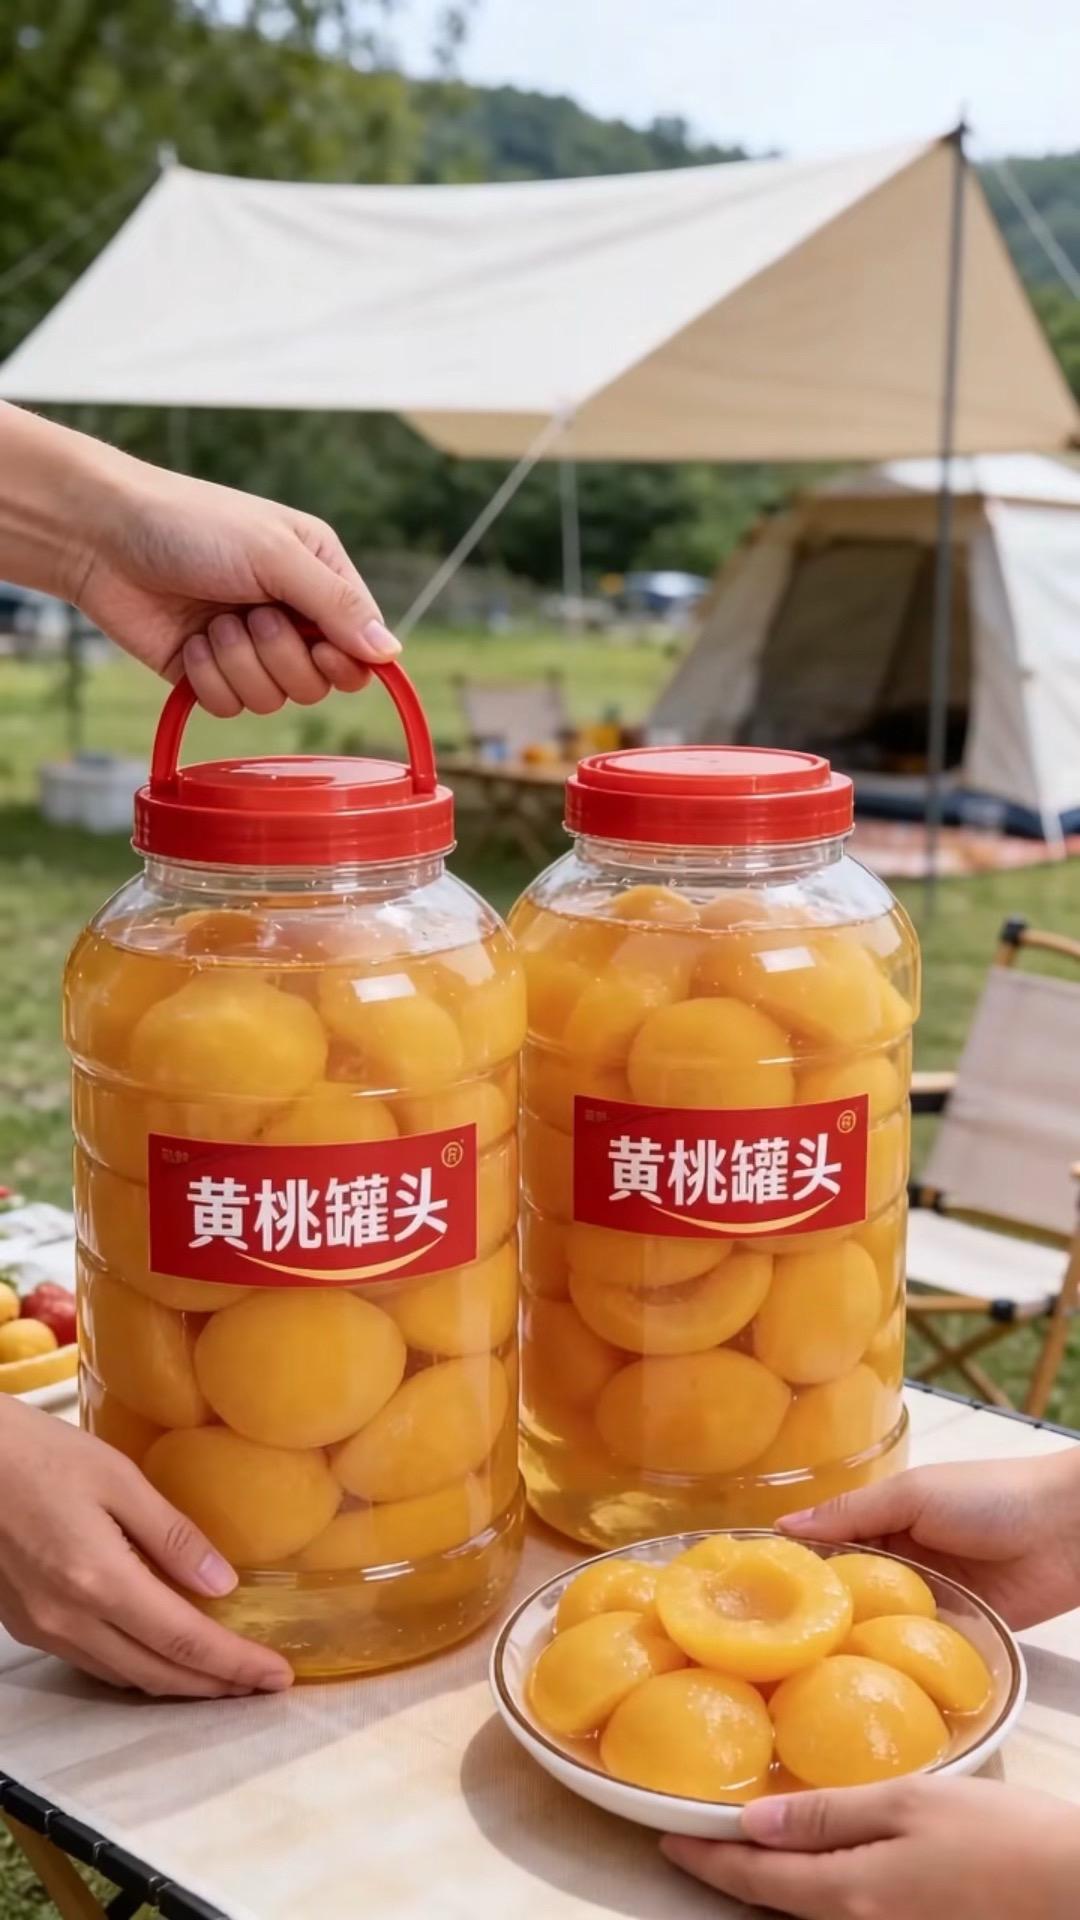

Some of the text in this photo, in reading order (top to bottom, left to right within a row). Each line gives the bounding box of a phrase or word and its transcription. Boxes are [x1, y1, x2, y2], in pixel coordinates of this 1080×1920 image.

[608, 1133, 842, 1205] 黄桃罐头
[186, 1167, 448, 1252] 黄桃罐头
